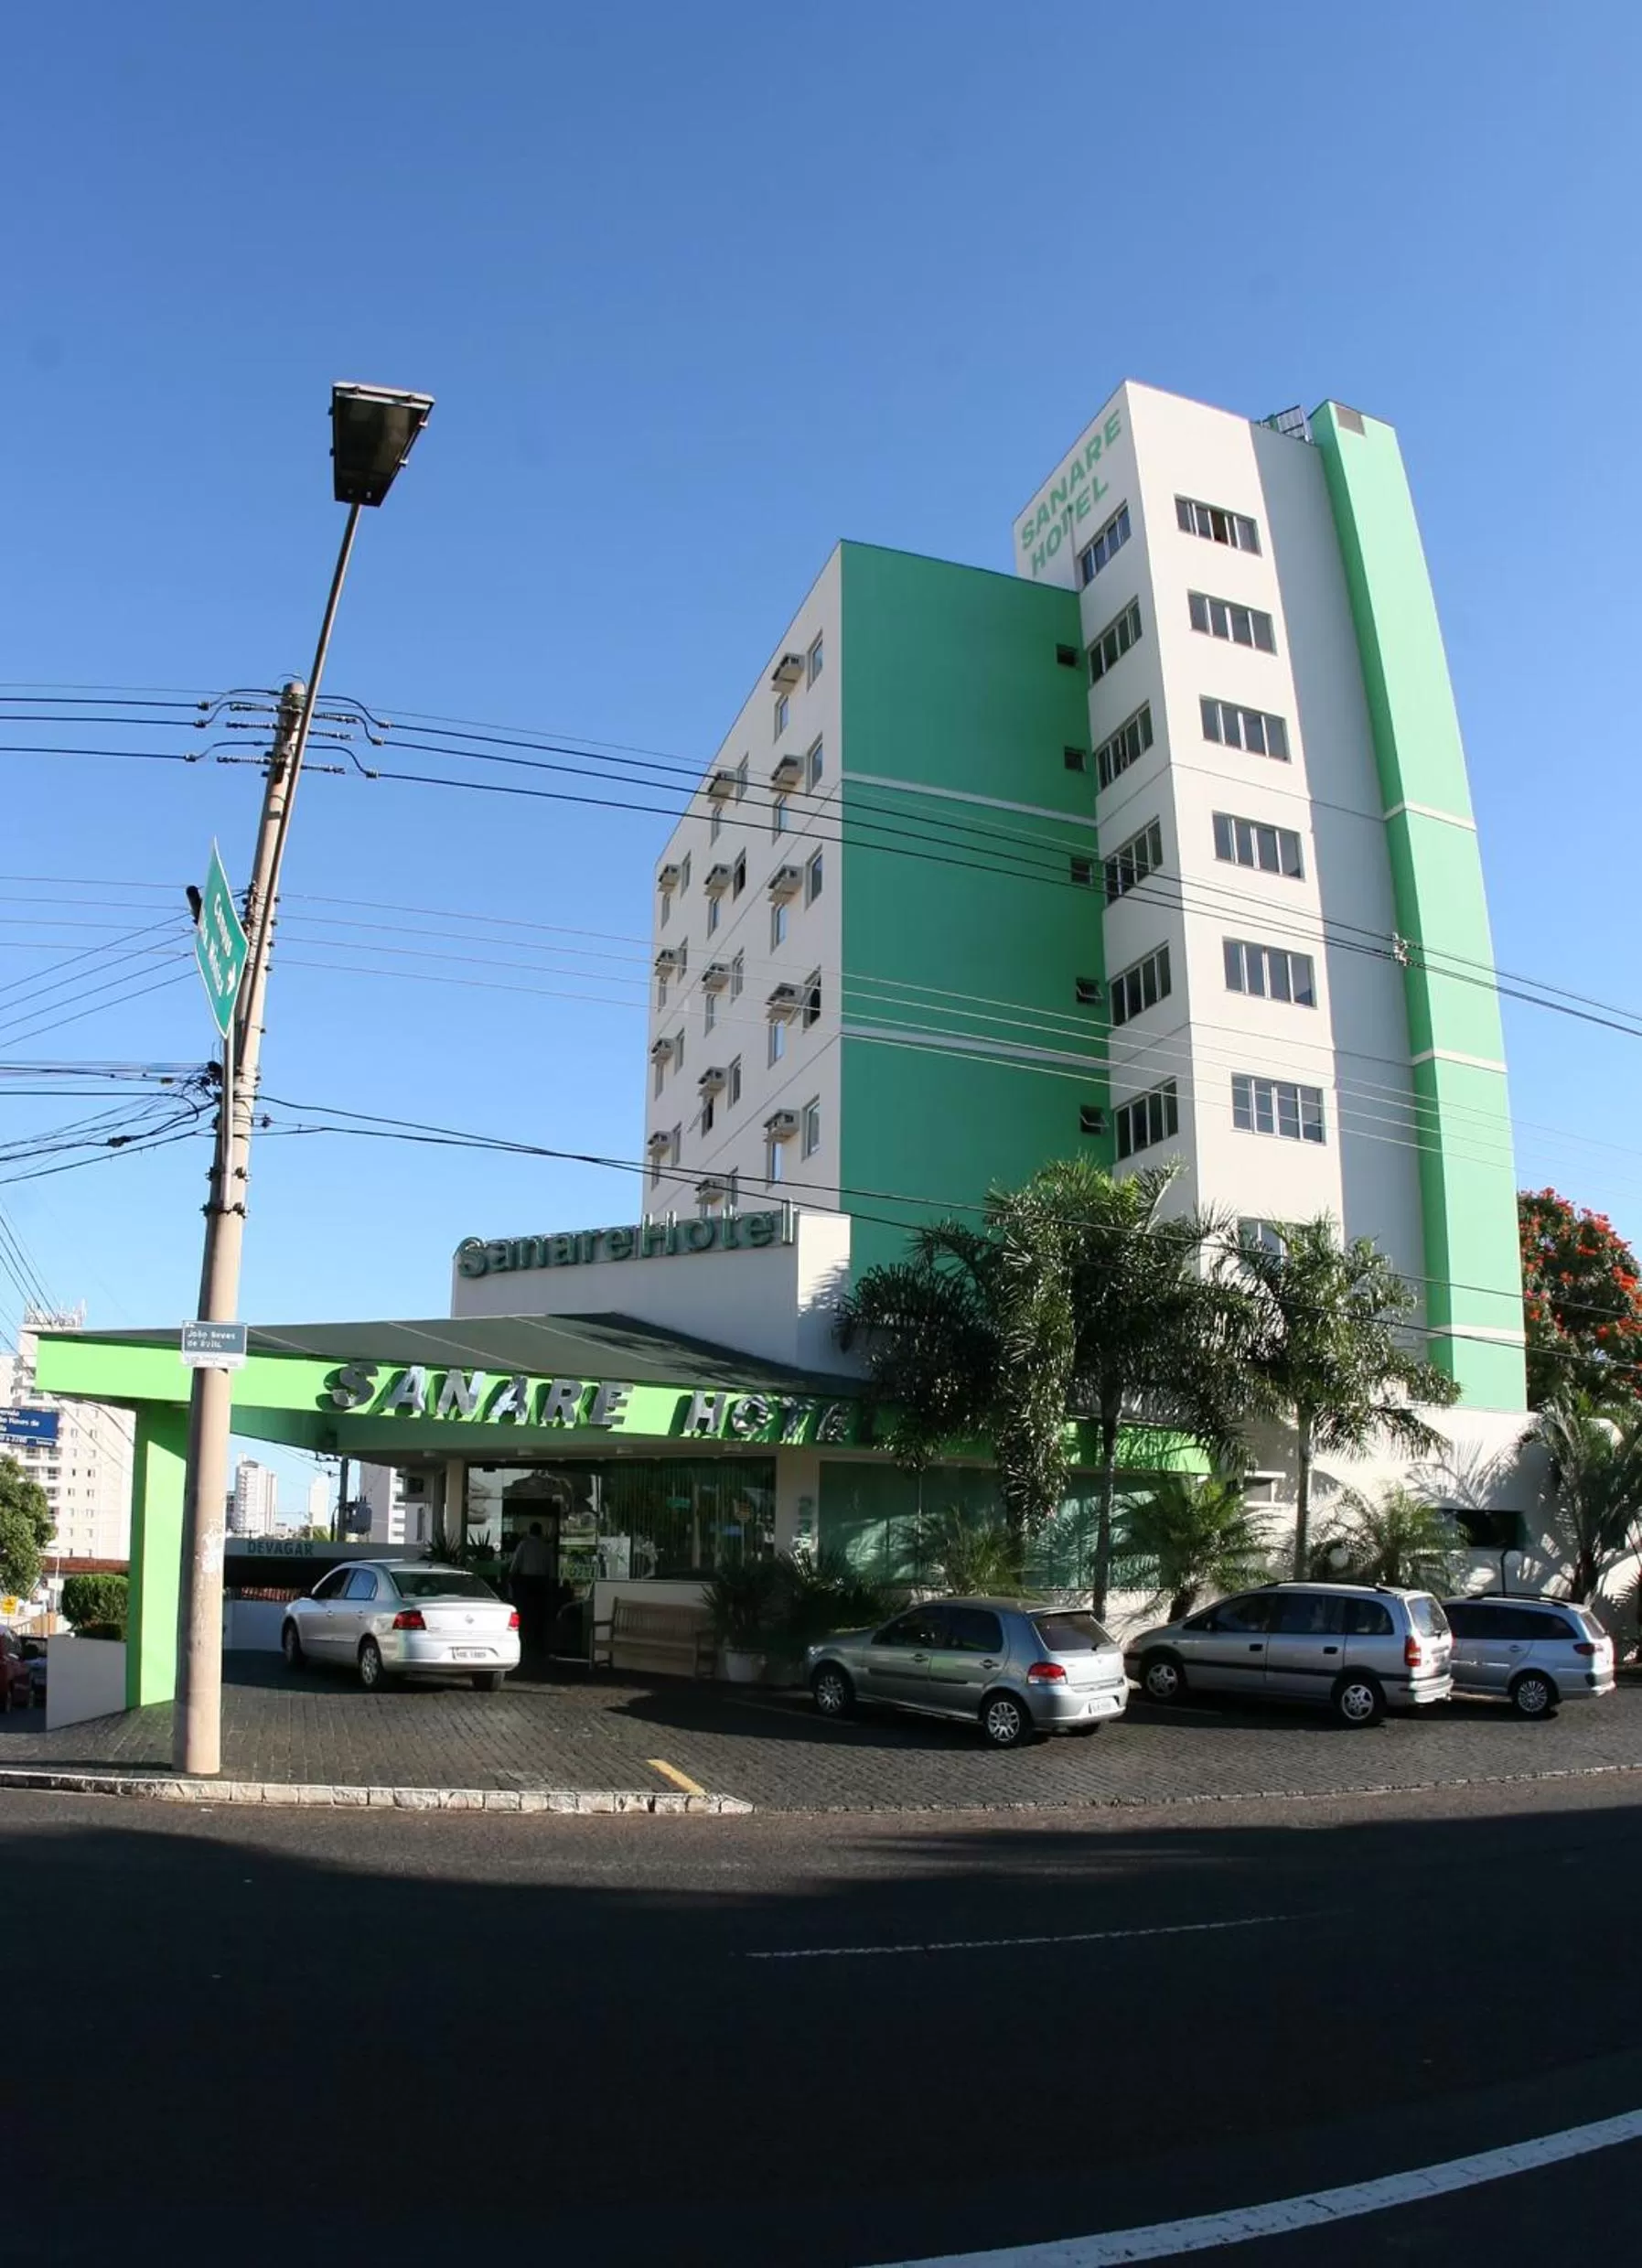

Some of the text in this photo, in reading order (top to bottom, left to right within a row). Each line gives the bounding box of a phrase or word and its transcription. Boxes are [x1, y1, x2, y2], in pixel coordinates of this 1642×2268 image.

[1021, 409, 1121, 550] SANARE
[1030, 475, 1109, 577] HOTEL
[456, 1198, 795, 1278] Sanare Hotel
[330, 1361, 635, 1425] SANARE
[247, 1541, 315, 1556] DEVAGAR
